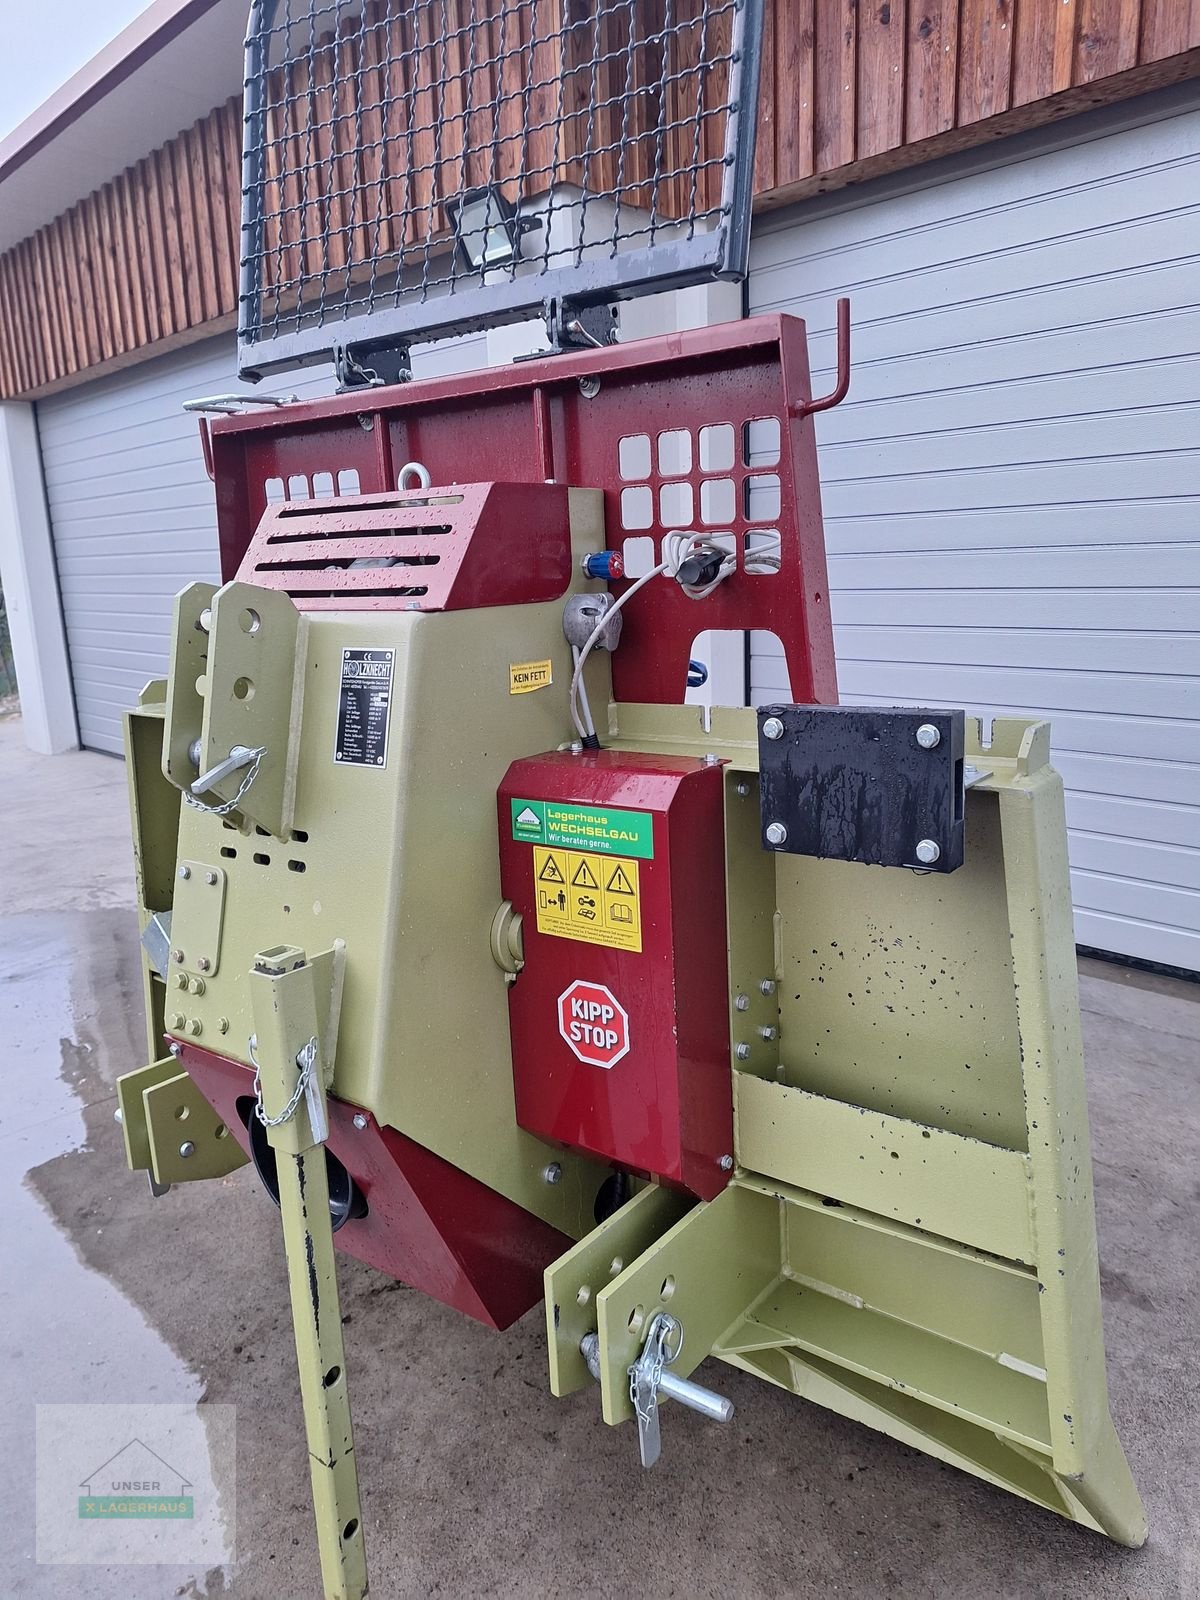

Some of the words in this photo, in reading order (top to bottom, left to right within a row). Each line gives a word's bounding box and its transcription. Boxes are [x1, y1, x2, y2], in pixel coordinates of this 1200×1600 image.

[513, 672, 529, 683] KEIN
[530, 670, 546, 681] FETT
[547, 809, 608, 824] Lagerhaus
[548, 822, 639, 842] WECHSELGAU
[548, 833, 561, 841] Wir
[561, 834, 588, 846] beraten
[589, 838, 612, 849] gerne.
[571, 997, 614, 1024] KIPP
[569, 1021, 618, 1049] STOP
